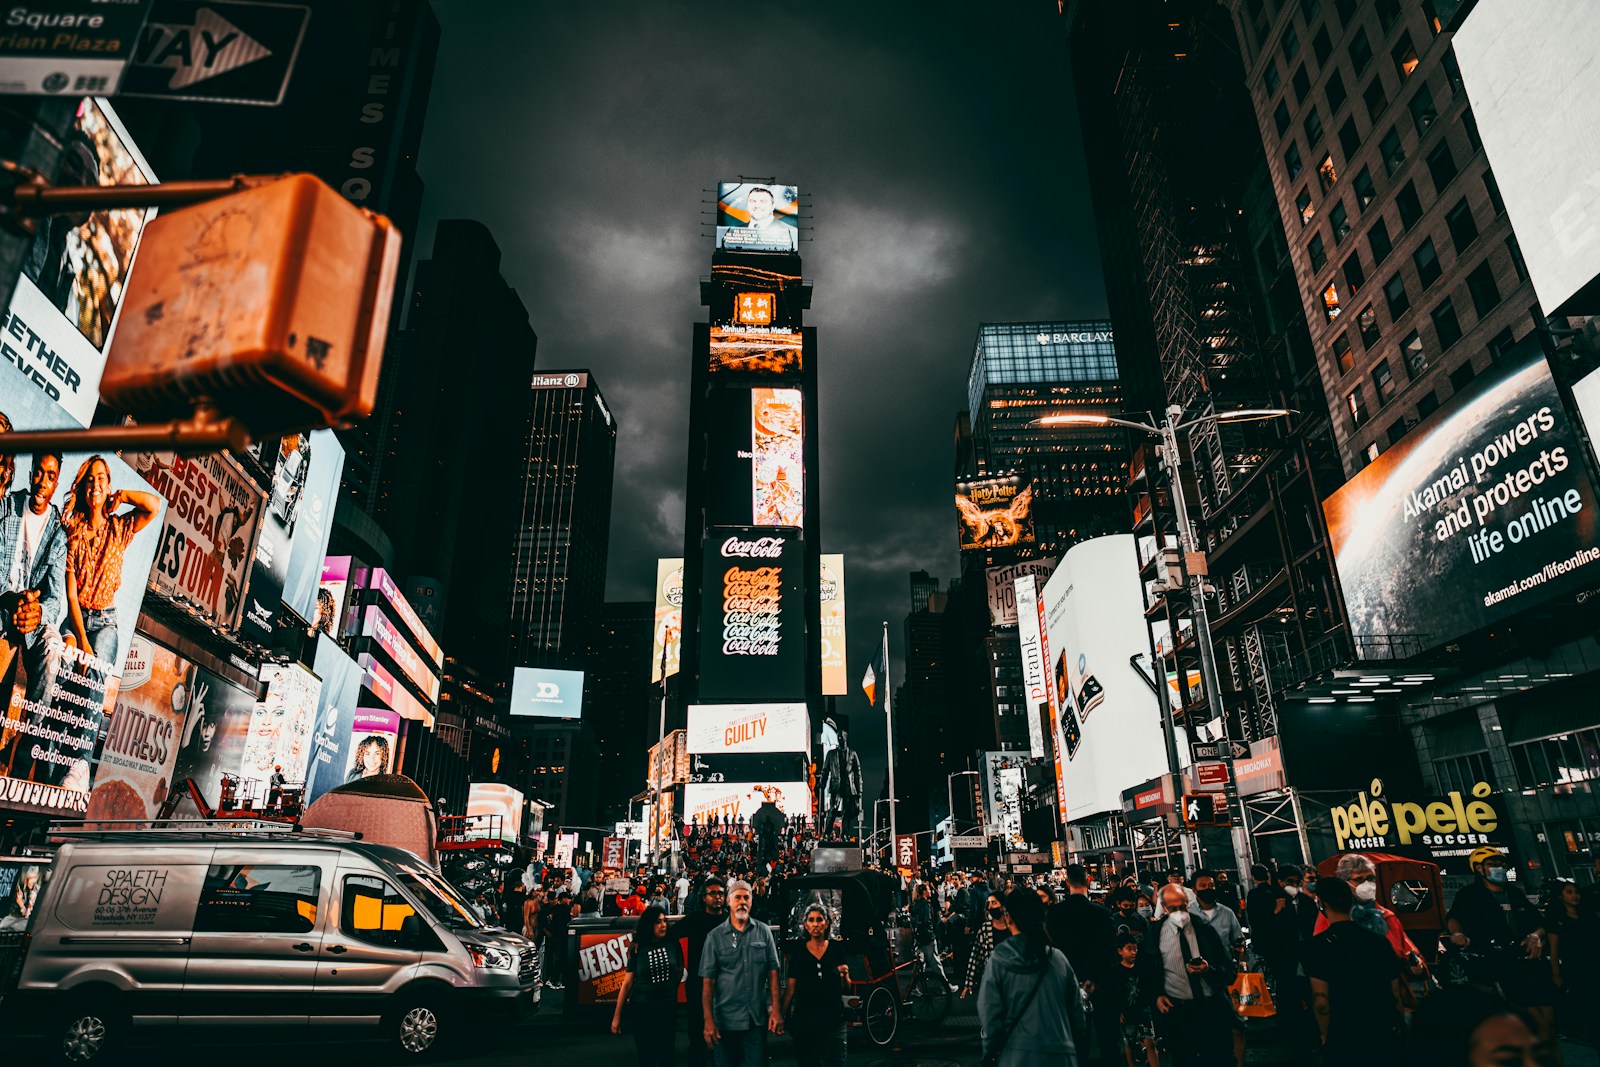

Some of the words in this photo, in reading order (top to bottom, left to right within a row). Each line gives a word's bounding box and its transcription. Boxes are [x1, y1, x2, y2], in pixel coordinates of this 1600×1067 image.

[6, 7, 105, 29] Square
[51, 32, 122, 52] Plaza
[721, 325, 746, 334] Xinhua
[746, 326, 770, 334] Screen
[771, 326, 792, 335] Media
[1403, 457, 1469, 524] Akamai
[1470, 406, 1555, 483] powers
[171, 453, 219, 508] BEST
[225, 475, 251, 510] AWARDS
[970, 487, 992, 503] Harry
[992, 485, 1017, 499] Potter
[1435, 501, 1471, 542] and
[1473, 445, 1569, 527] protects
[1468, 526, 1505, 565] life
[1506, 488, 1584, 545] online
[720, 536, 785, 558] Coca-Cola
[995, 565, 1027, 587] LITTLE
[246, 610, 273, 633] ARCIMOTO
[1022, 634, 1046, 700] pfrank
[50, 682, 104, 714] @jennaortega
[11, 692, 99, 733] @madisonbaileybabe
[724, 717, 767, 747] GUILTY
[112, 756, 138, 769] BROADWAY
[138, 763, 157, 775] MUSICAL
[1244, 757, 1272, 773] BROADWAY
[1349, 836, 1386, 850] SOCCER
[1422, 834, 1489, 845] SOCCER
[608, 840, 622, 867] tkts
[900, 837, 913, 866] tkts
[103, 870, 169, 888] SPAETH
[98, 888, 163, 905] DESIGN
[95, 906, 115, 914] 60-06
[578, 933, 633, 982] JERSE
